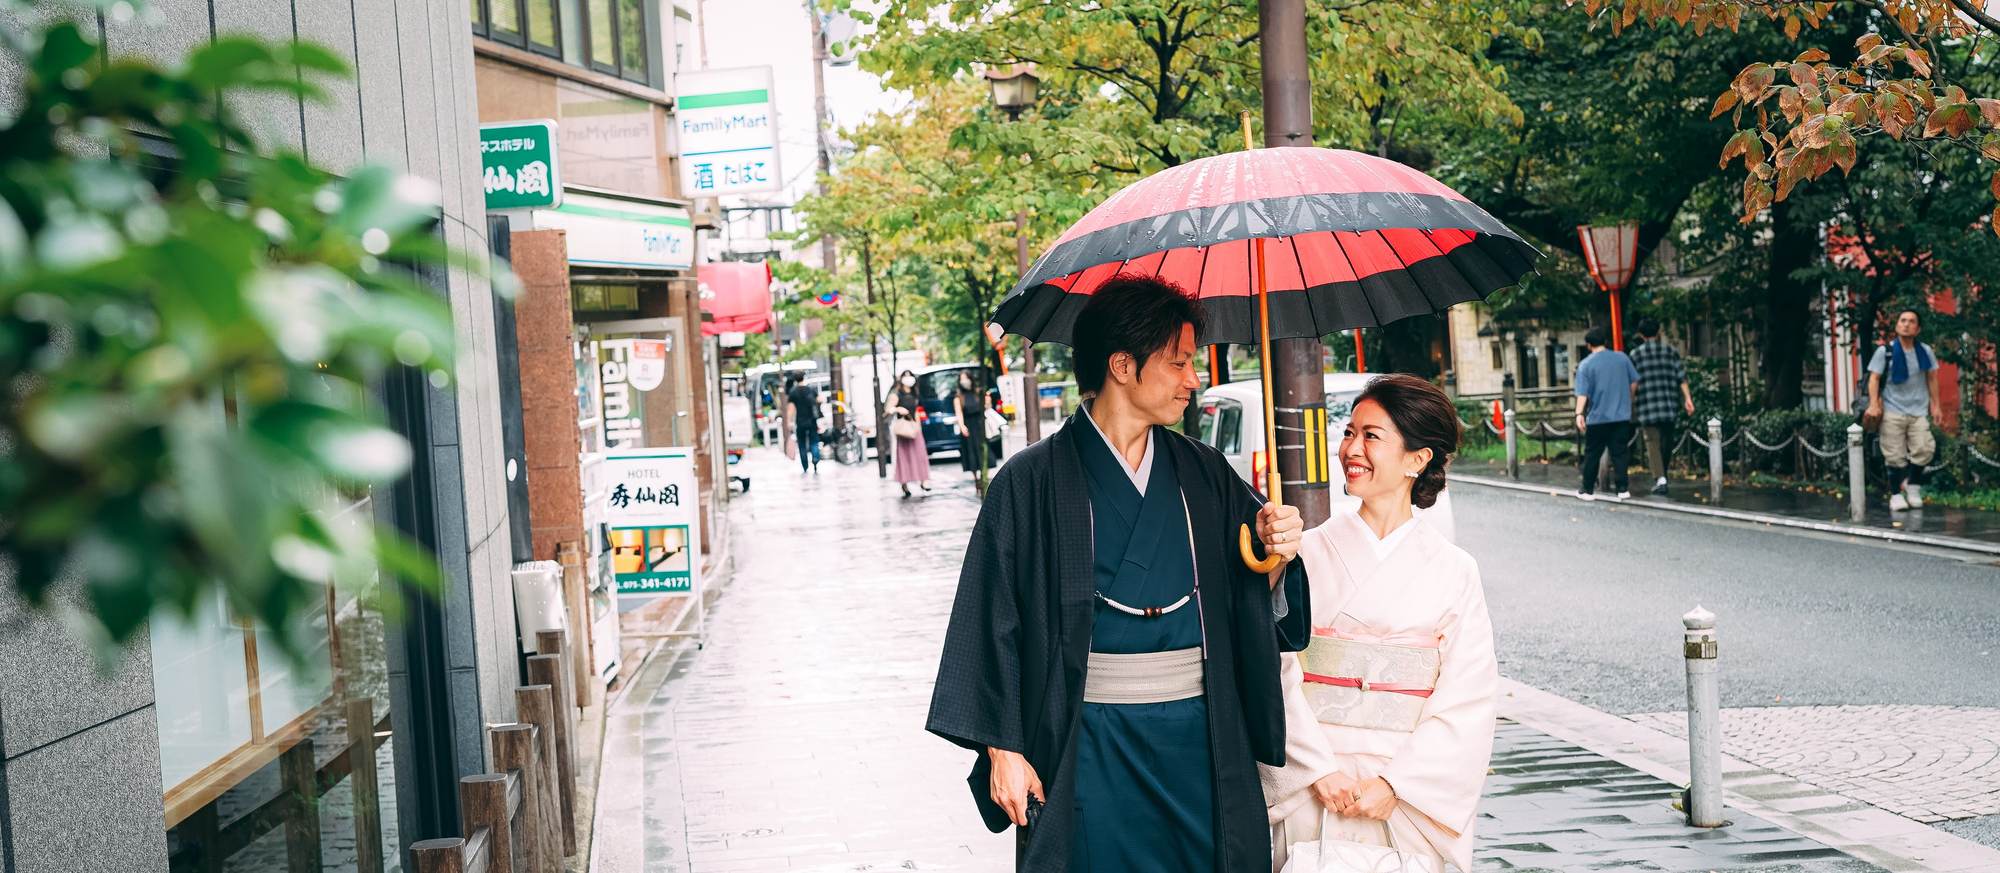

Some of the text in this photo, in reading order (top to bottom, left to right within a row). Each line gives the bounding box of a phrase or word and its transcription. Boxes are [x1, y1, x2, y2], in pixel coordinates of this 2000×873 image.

[682, 114, 768, 134] FamilyMart
[693, 160, 767, 190] 酒 たばこ
[627, 468, 662, 479] HOTEL
